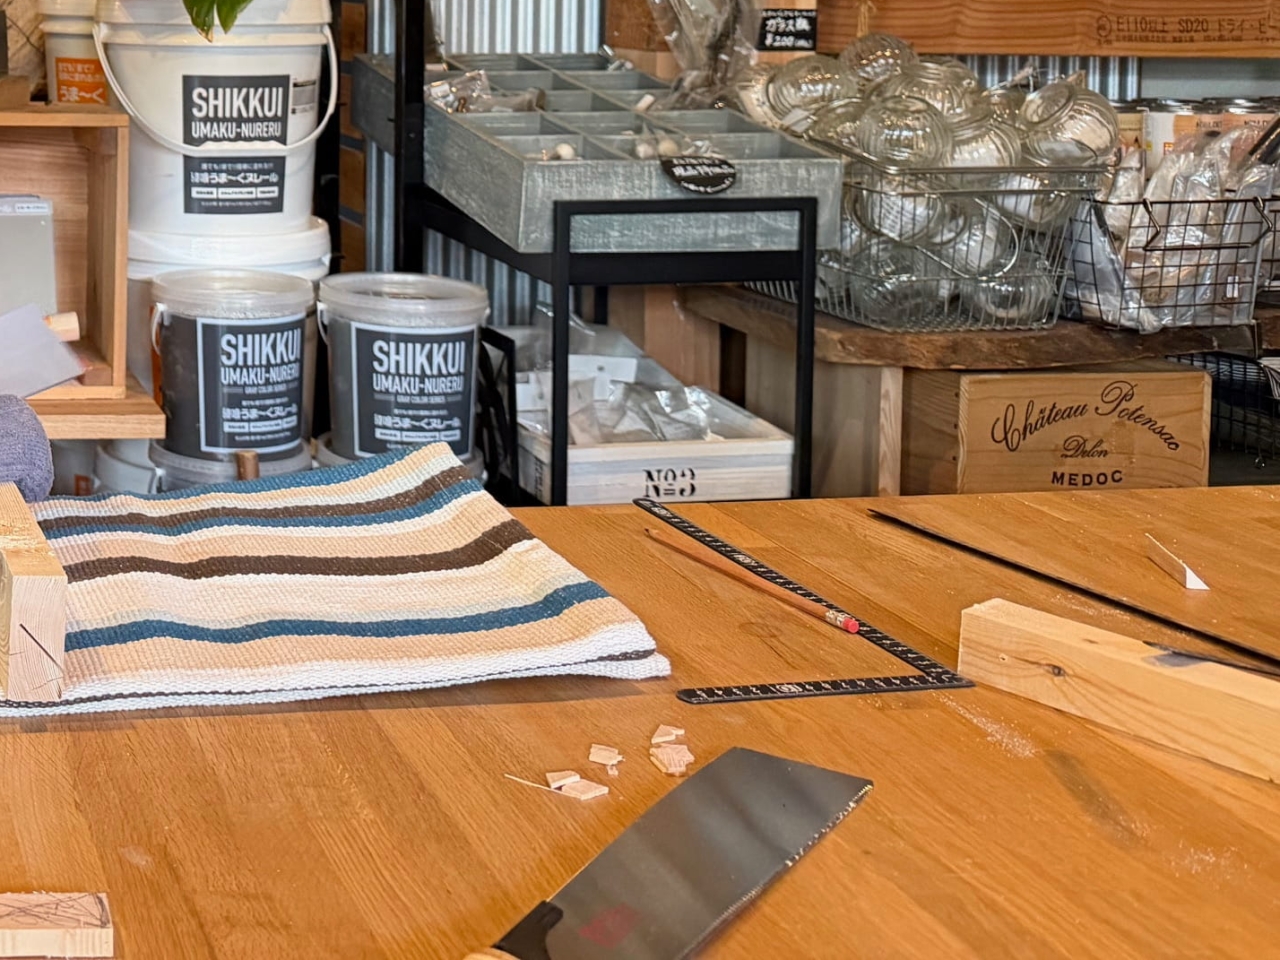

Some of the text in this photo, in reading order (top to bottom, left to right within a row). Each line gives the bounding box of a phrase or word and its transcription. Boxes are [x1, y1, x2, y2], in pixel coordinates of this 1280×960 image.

[1178, 17, 1209, 34] SD20
[192, 87, 283, 119] SHIKKUI
[191, 121, 281, 139] UMAKU-NURERU
[220, 328, 301, 366] SHIKKUI
[372, 340, 466, 375] SHIKKUI
[372, 373, 464, 394] UMAKU-NURERU
[1060, 434, 1109, 459] Delon
[1051, 470, 1123, 487] MEDOC
